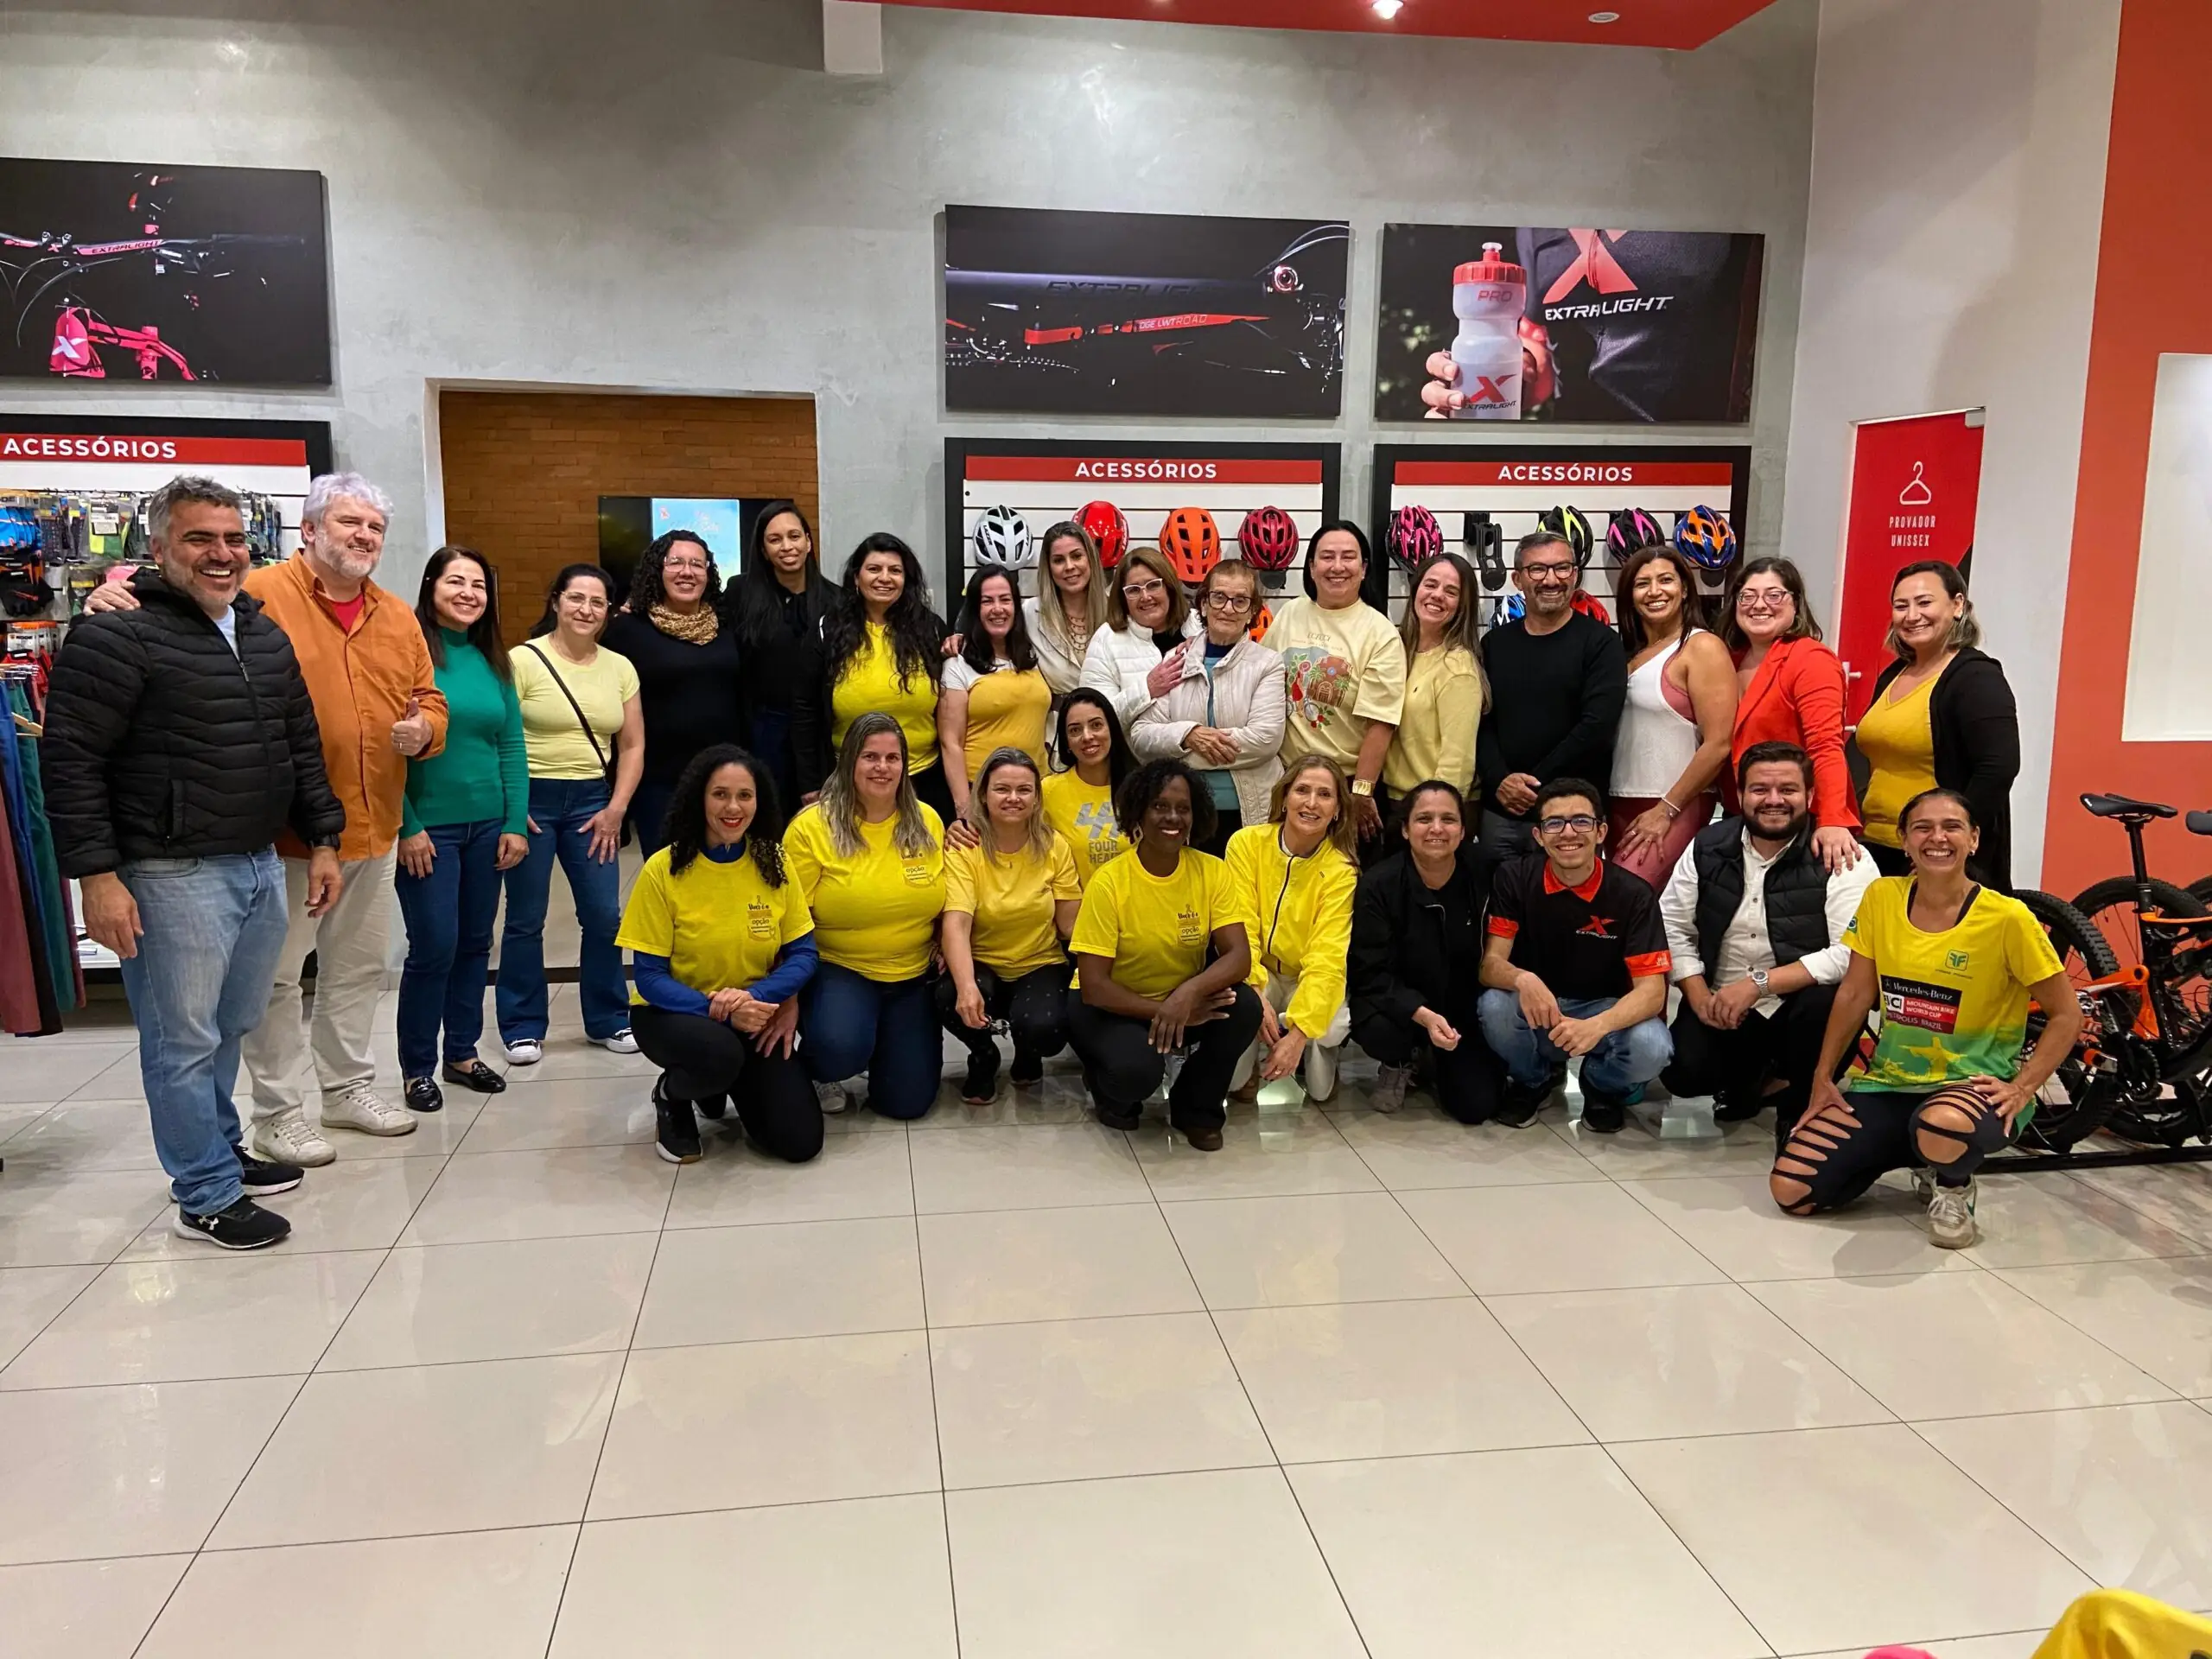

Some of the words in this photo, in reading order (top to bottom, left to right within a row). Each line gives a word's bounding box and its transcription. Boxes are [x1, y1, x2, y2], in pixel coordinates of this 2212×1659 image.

[92, 240, 159, 255] EXTRALIGHT
[1478, 289, 1514, 303] PRO
[1545, 296, 1675, 321] EXTRALIGHT
[1465, 400, 1517, 411] XTRALIGHT
[3, 435, 177, 459] ACESSÓRIOS
[1075, 459, 1217, 479] ACESSÓRIOS
[1497, 462, 1632, 482] ACESSÓRIOS
[1889, 515, 1936, 528] PROVADOR
[1891, 534, 1930, 547] UNISSEX
[1089, 840, 1118, 852] FOUR
[1893, 982, 1953, 1001] Mercedes-Benz
[1906, 1000, 1940, 1012] MOUNTAIN
[1941, 1006, 1955, 1014] BIKE
[1906, 1007, 1929, 1015] WORLD
[1921, 1019, 1942, 1031] BRAZIL
